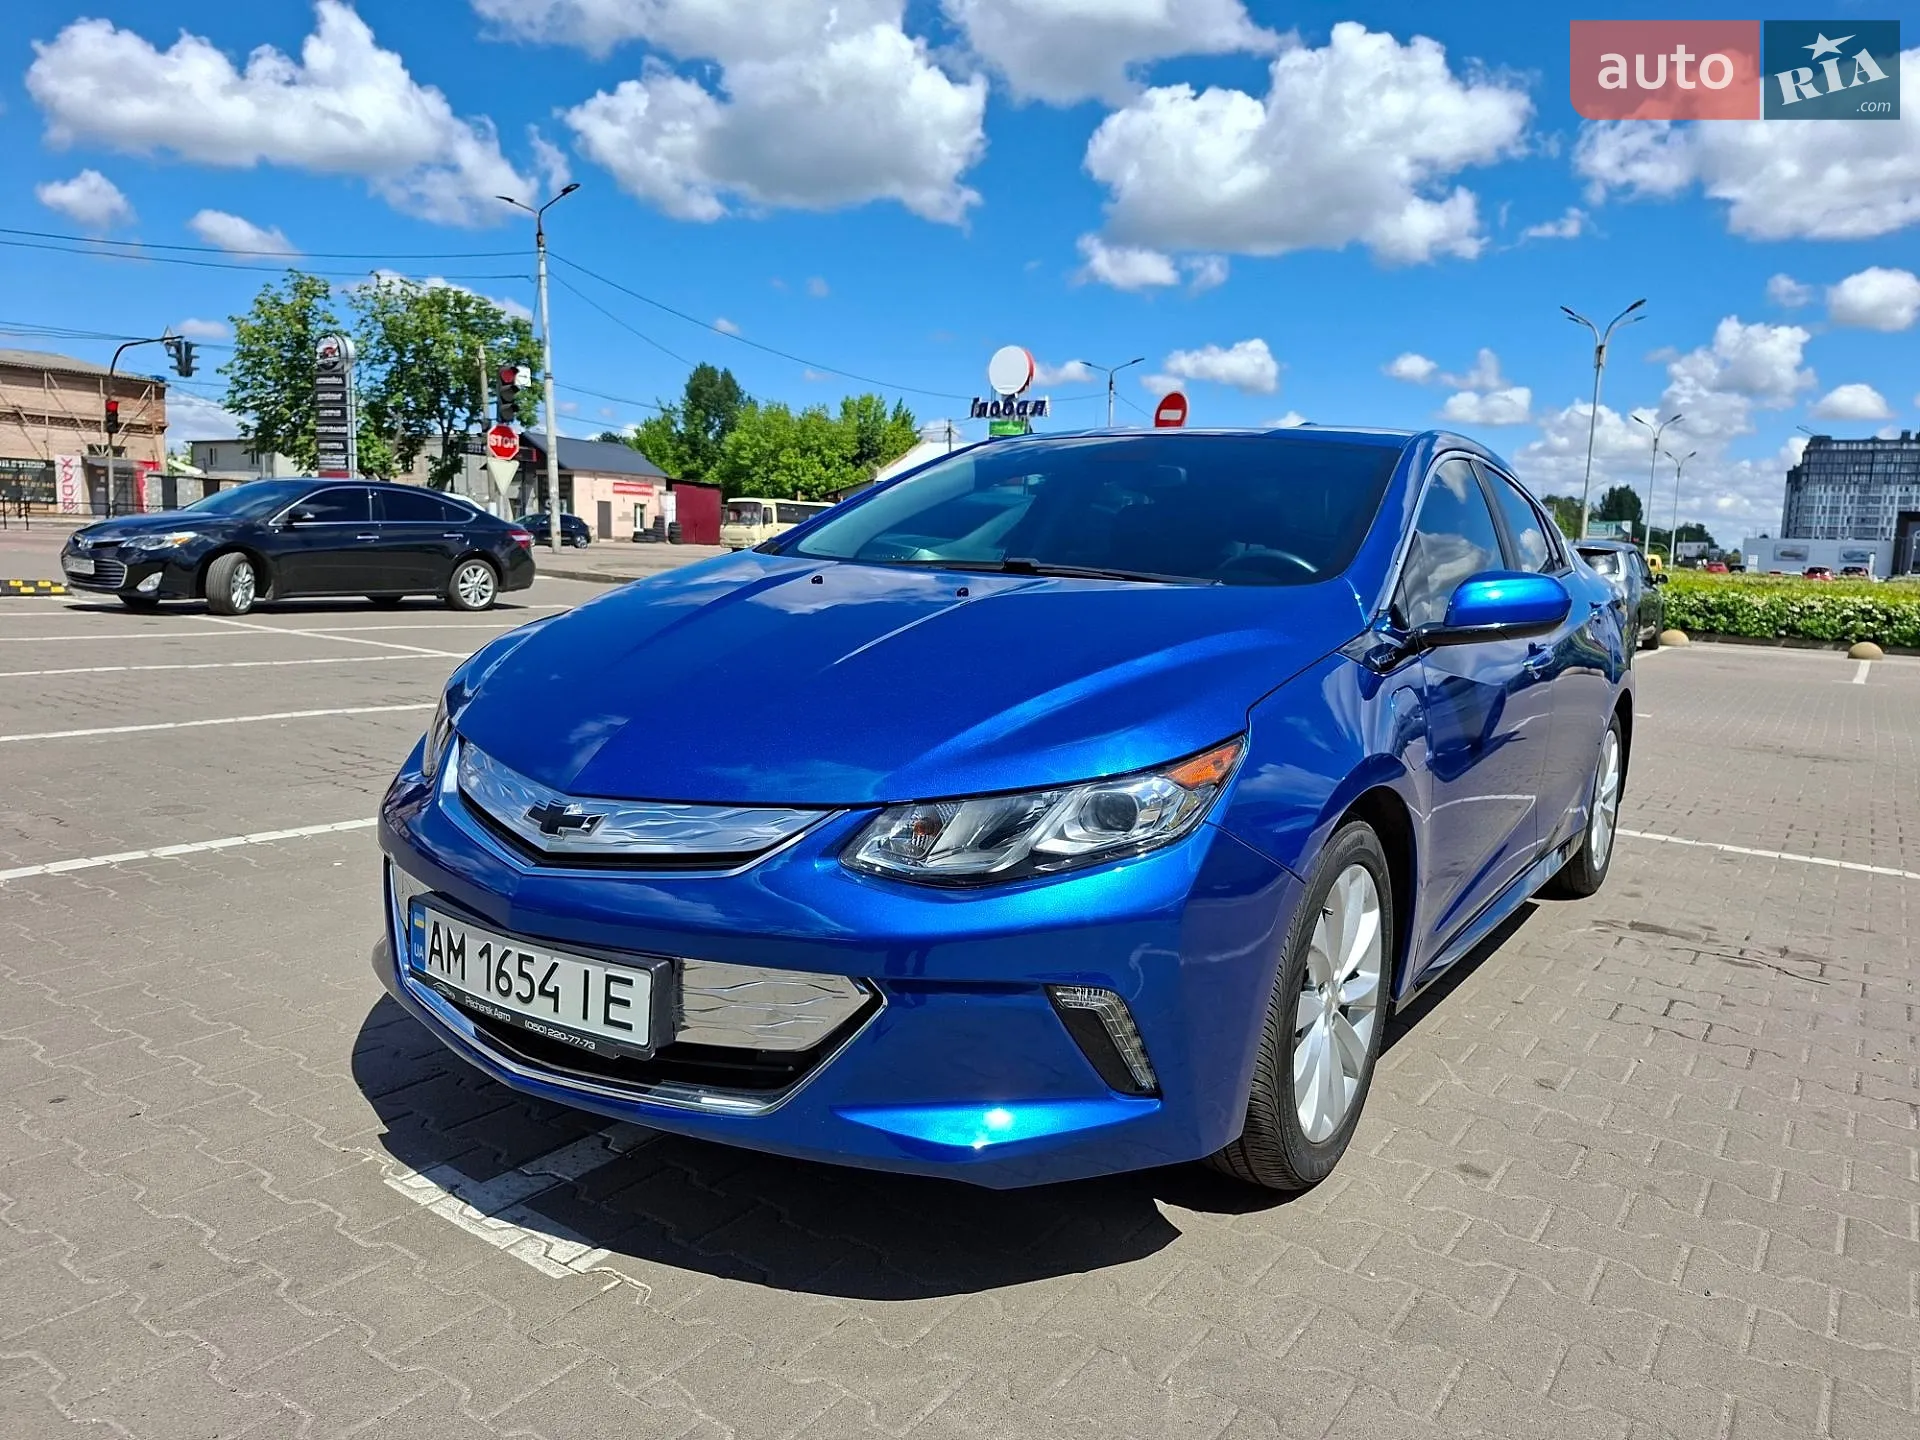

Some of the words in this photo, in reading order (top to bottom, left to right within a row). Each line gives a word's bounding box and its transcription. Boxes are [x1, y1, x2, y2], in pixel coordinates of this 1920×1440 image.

[489, 434, 518, 448] STOP
[414, 941, 424, 960] UA
[428, 920, 466, 981] AM
[478, 942, 560, 1013] 1654
[582, 969, 634, 1031] IE
[524, 1019, 547, 1035] (050)
[547, 1029, 596, 1050] 220-77-73
